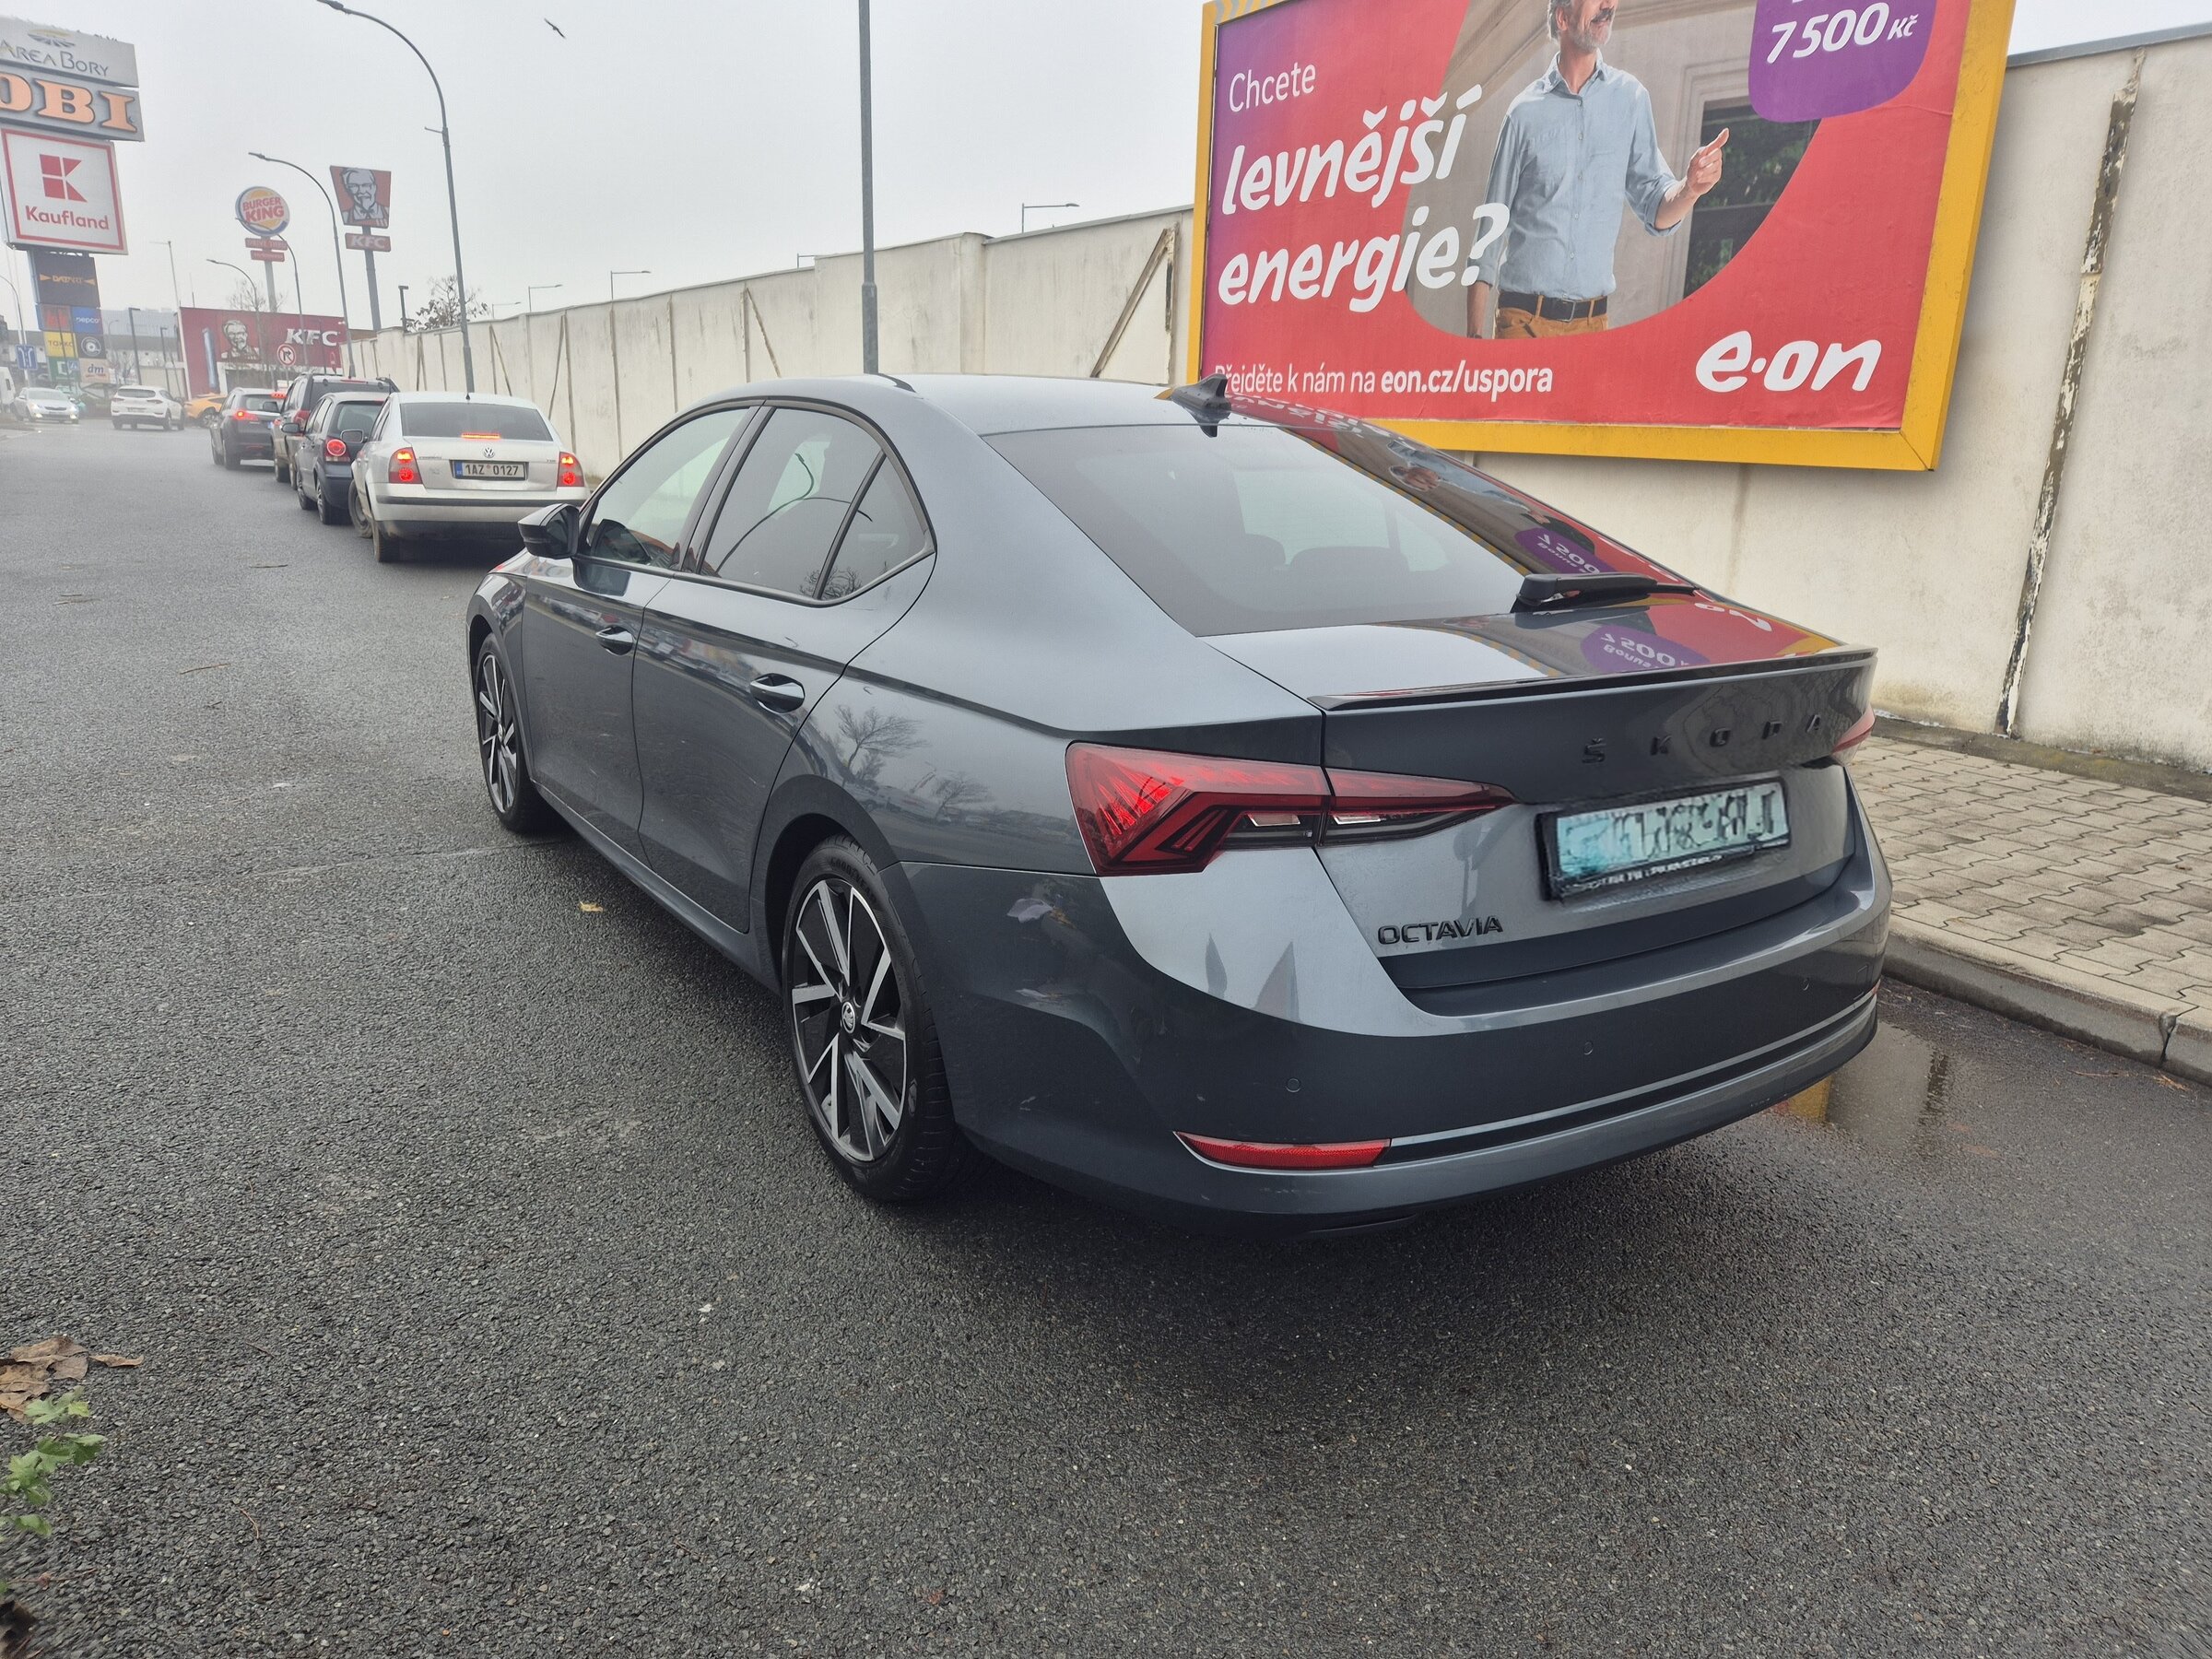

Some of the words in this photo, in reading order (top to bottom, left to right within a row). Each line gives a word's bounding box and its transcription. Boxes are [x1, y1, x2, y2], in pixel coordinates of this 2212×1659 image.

[1887, 13, 1920, 41] Kč
[1229, 61, 1316, 112] Chcete
[1221, 84, 1483, 216] levnější
[242, 196, 282, 211] BURGER
[245, 206, 285, 222] KING
[25, 205, 110, 230] Kaufland
[351, 235, 386, 250] KFC
[1218, 202, 1511, 313] energie?
[284, 328, 338, 347] KFC
[88, 363, 104, 373] dm
[1288, 363, 1299, 393] k
[1302, 361, 1345, 394] nám
[1350, 370, 1375, 393] na
[1381, 359, 1553, 403] eon.cz/uspora
[465, 464, 486, 476] 1AZ
[493, 465, 519, 476] 0127
[1377, 915, 1504, 946] OCTAVIA
